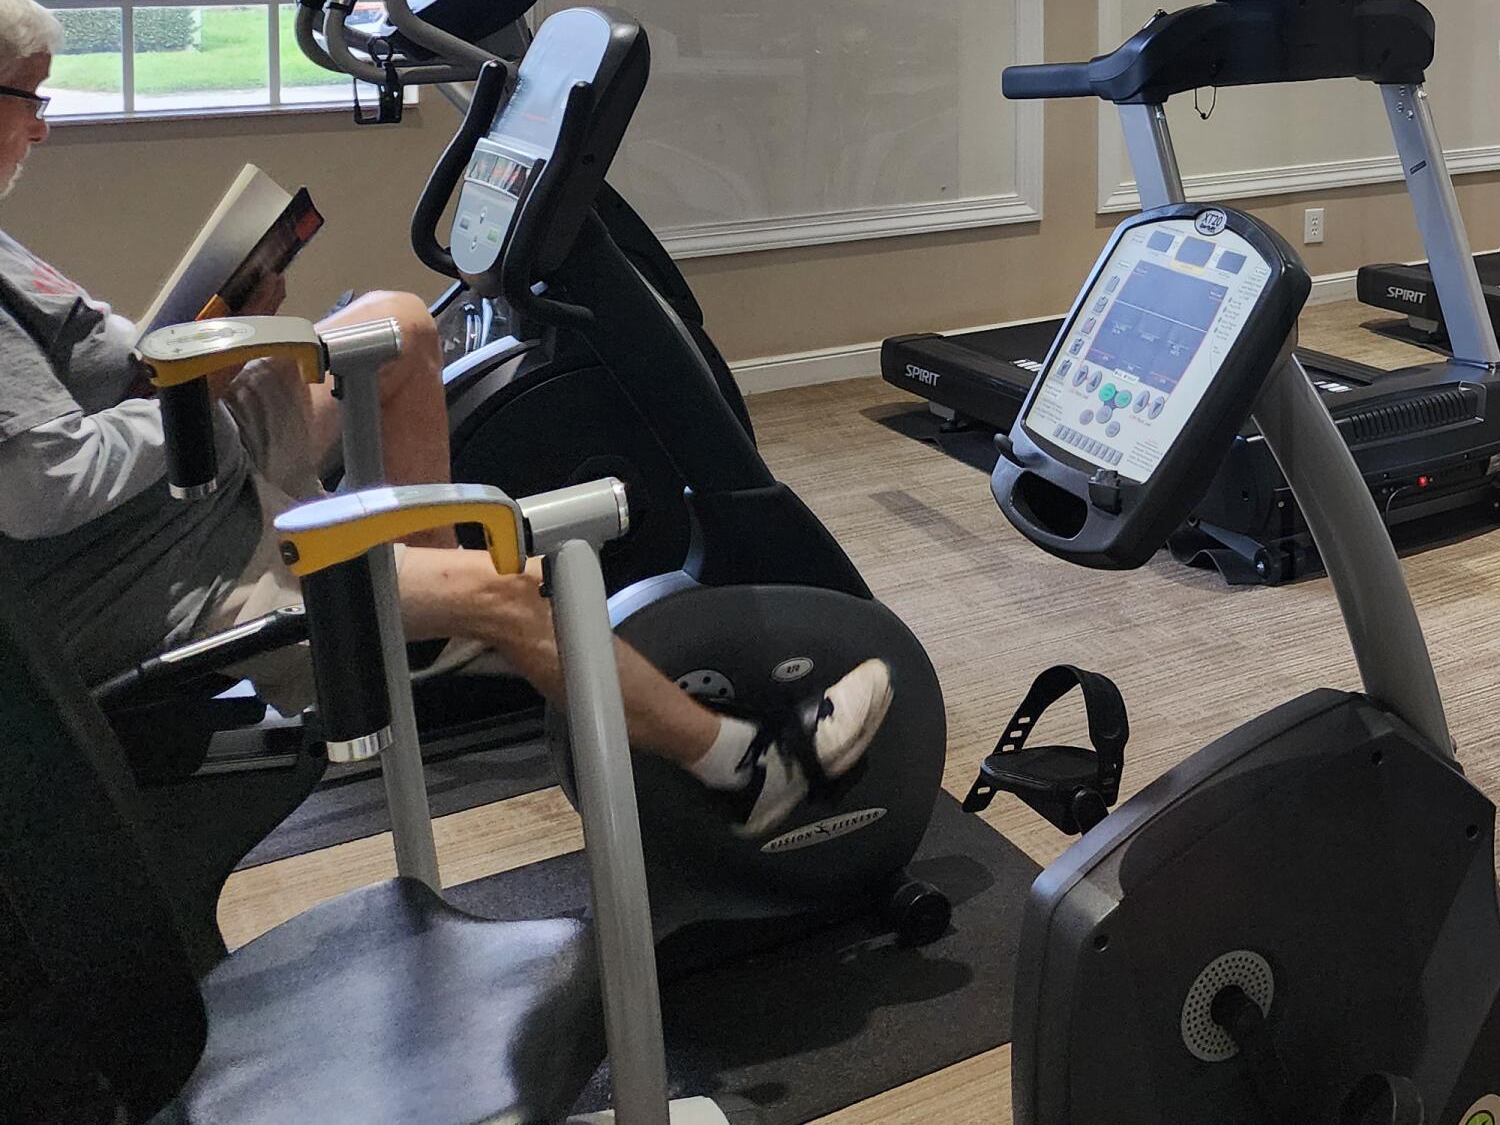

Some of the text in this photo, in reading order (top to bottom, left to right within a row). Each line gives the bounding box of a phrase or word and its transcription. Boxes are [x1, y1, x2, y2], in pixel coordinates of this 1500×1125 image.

[1386, 286, 1427, 304] SPIRIT
[905, 364, 940, 387] SPIRIT
[770, 831, 812, 849] VISION
